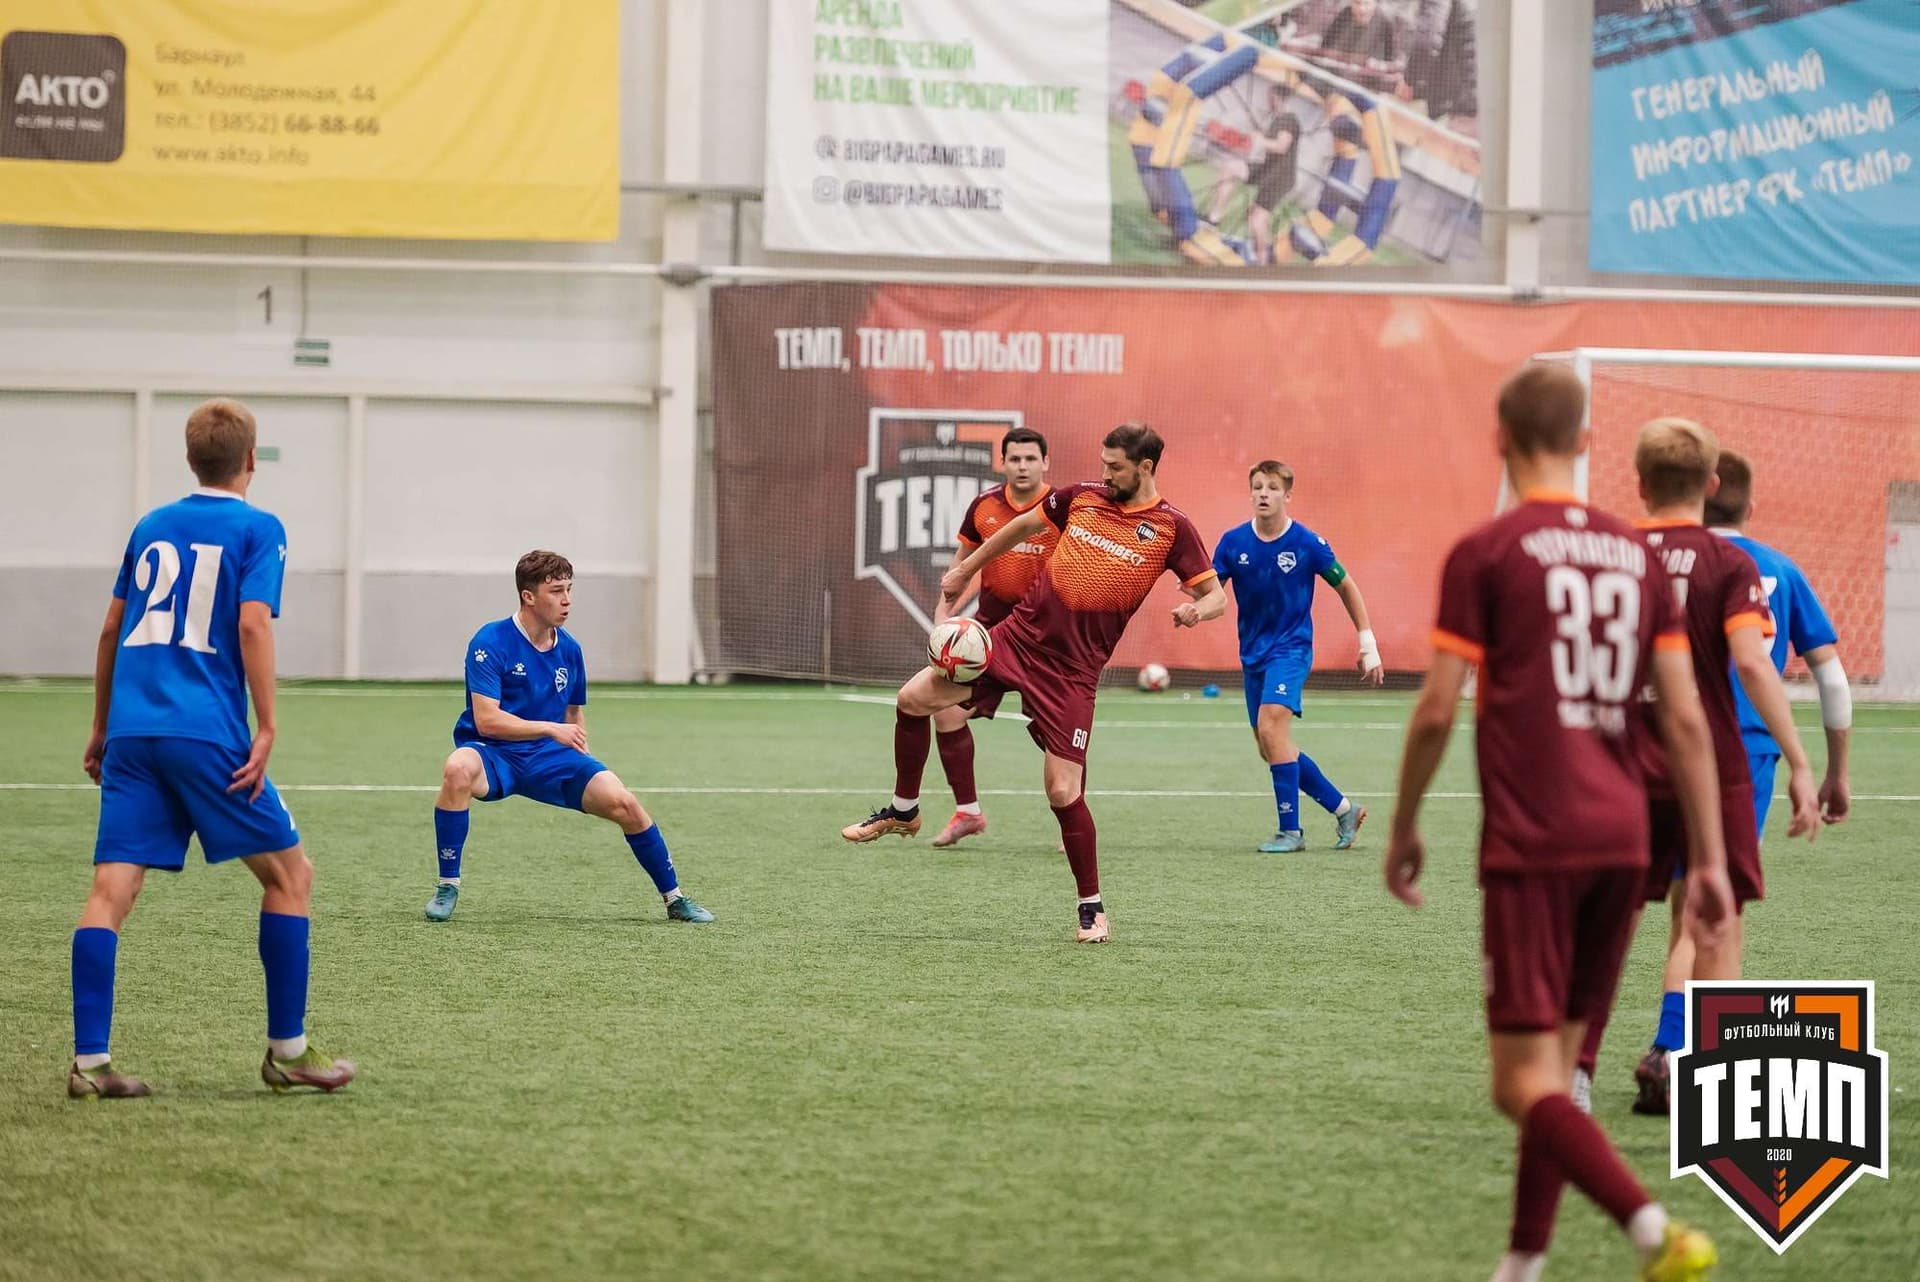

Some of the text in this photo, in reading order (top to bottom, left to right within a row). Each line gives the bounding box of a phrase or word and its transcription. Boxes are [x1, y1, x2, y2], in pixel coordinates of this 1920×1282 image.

[350, 85, 376, 102] 44
[813, 75, 1079, 113] НА ВАШЕ МЕРОПРИЯТИЕ
[1631, 47, 1826, 121] ГЕНЕРАЛЬНЫЙ
[209, 111, 278, 134] (3852)
[284, 112, 380, 137] 66-88-66
[1630, 88, 1895, 181] ИНФОРМАЦИОННЫЙ
[844, 139, 1006, 169] BIGPAPAGAMES.RU
[844, 180, 1002, 210] @BIGPAPAGAMES
[1628, 148, 1912, 233] ПАРТНЕР ФК «ТЕМП»
[257, 285, 271, 324] 1
[774, 327, 1124, 374] ТЕМП, ТЕМП, ТОЛЬКО ТЕМП!
[875, 475, 1003, 554] ТЕМ
[1069, 525, 1145, 566] ПРОДИНВЕСТ
[123, 540, 223, 654] 21
[1546, 566, 1641, 702] 33
[1072, 728, 1088, 750] 60
